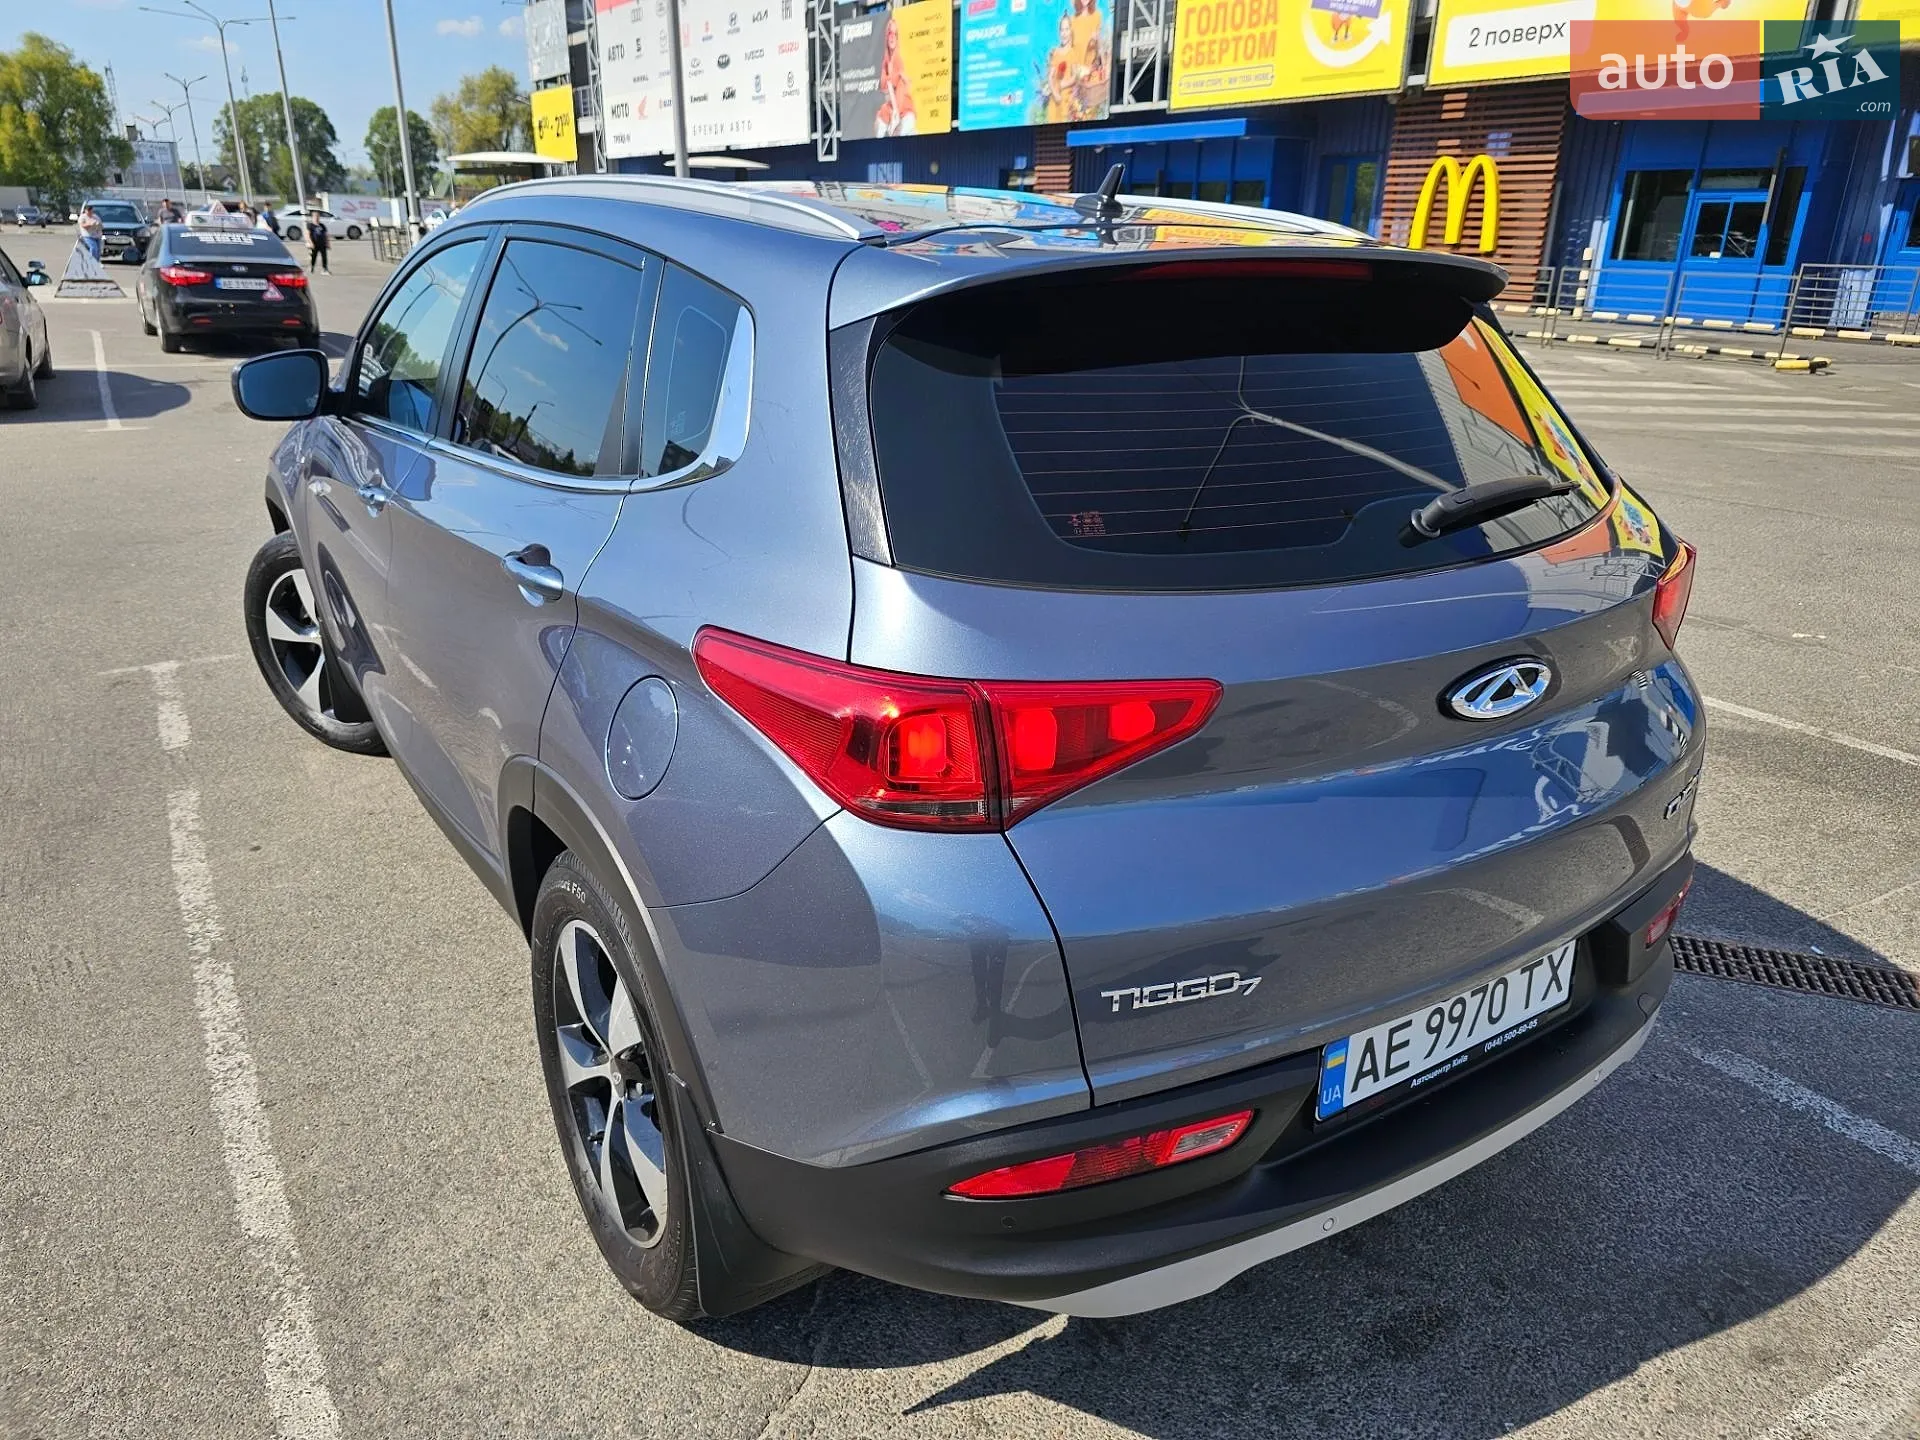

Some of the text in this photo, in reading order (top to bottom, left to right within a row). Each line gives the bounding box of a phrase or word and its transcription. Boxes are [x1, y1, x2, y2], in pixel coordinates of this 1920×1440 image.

[1184, 0, 1278, 38] ГОЛОВА
[1469, 22, 1566, 48] 2 поверх
[1351, 945, 1570, 1093] AE 9970 TX
[1410, 1063, 1451, 1088] Автоцентр
[1484, 1036, 1503, 1053] (044)
[1322, 1085, 1341, 1105] UA
